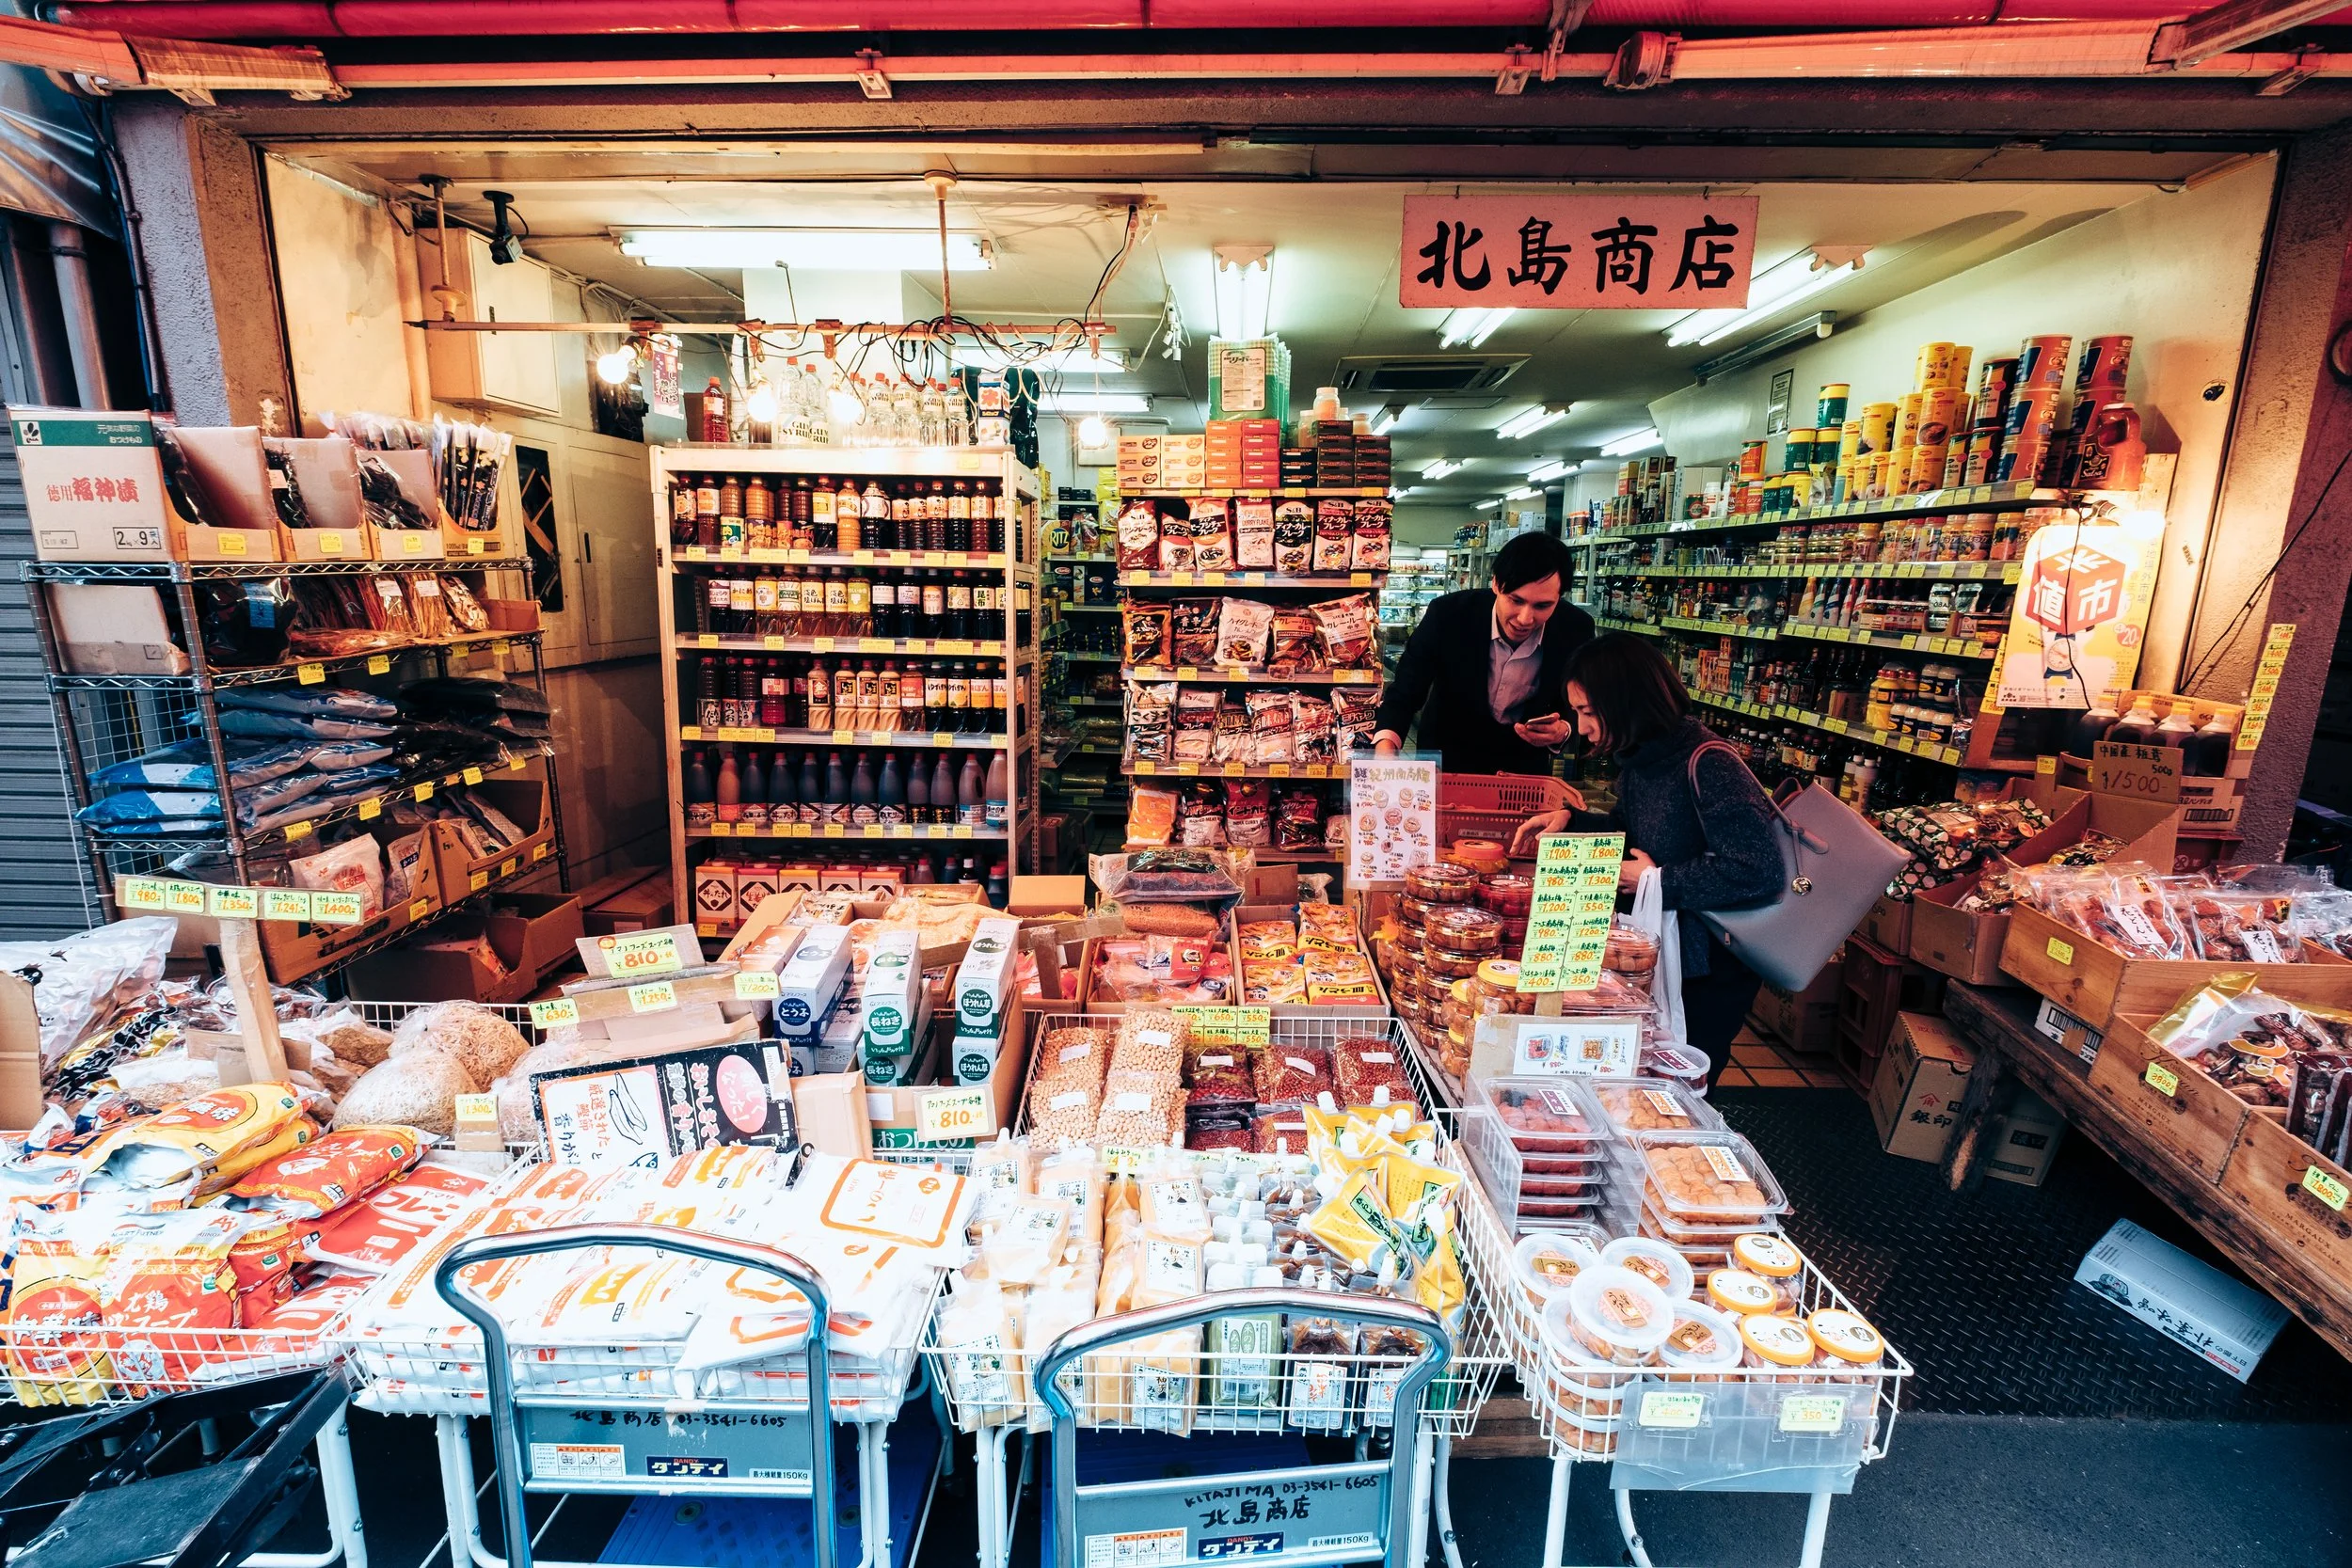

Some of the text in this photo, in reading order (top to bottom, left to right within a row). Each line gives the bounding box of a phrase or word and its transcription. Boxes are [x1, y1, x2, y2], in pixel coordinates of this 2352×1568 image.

[1416, 214, 1740, 295] 北島商店
[1050, 531, 1069, 546] RITZ
[962, 998, 992, 1008] ほうれん草
[780, 1008, 810, 1019] とうふ
[868, 1016, 901, 1027] 長ねぎ
[866, 1064, 895, 1074] 長ねぎ
[960, 1063, 989, 1073] ほうれん草
[2137, 1097, 2171, 1125] MARGAUX
[1910, 1110, 1953, 1128] 銀印
[2286, 1212, 2331, 1249] MARGAUX
[677, 1413, 787, 1428] 03-3541-6605
[1184, 1475, 1379, 1508] KITAJIMA 03-3541-6605
[1198, 1495, 1311, 1529] 北島商店
